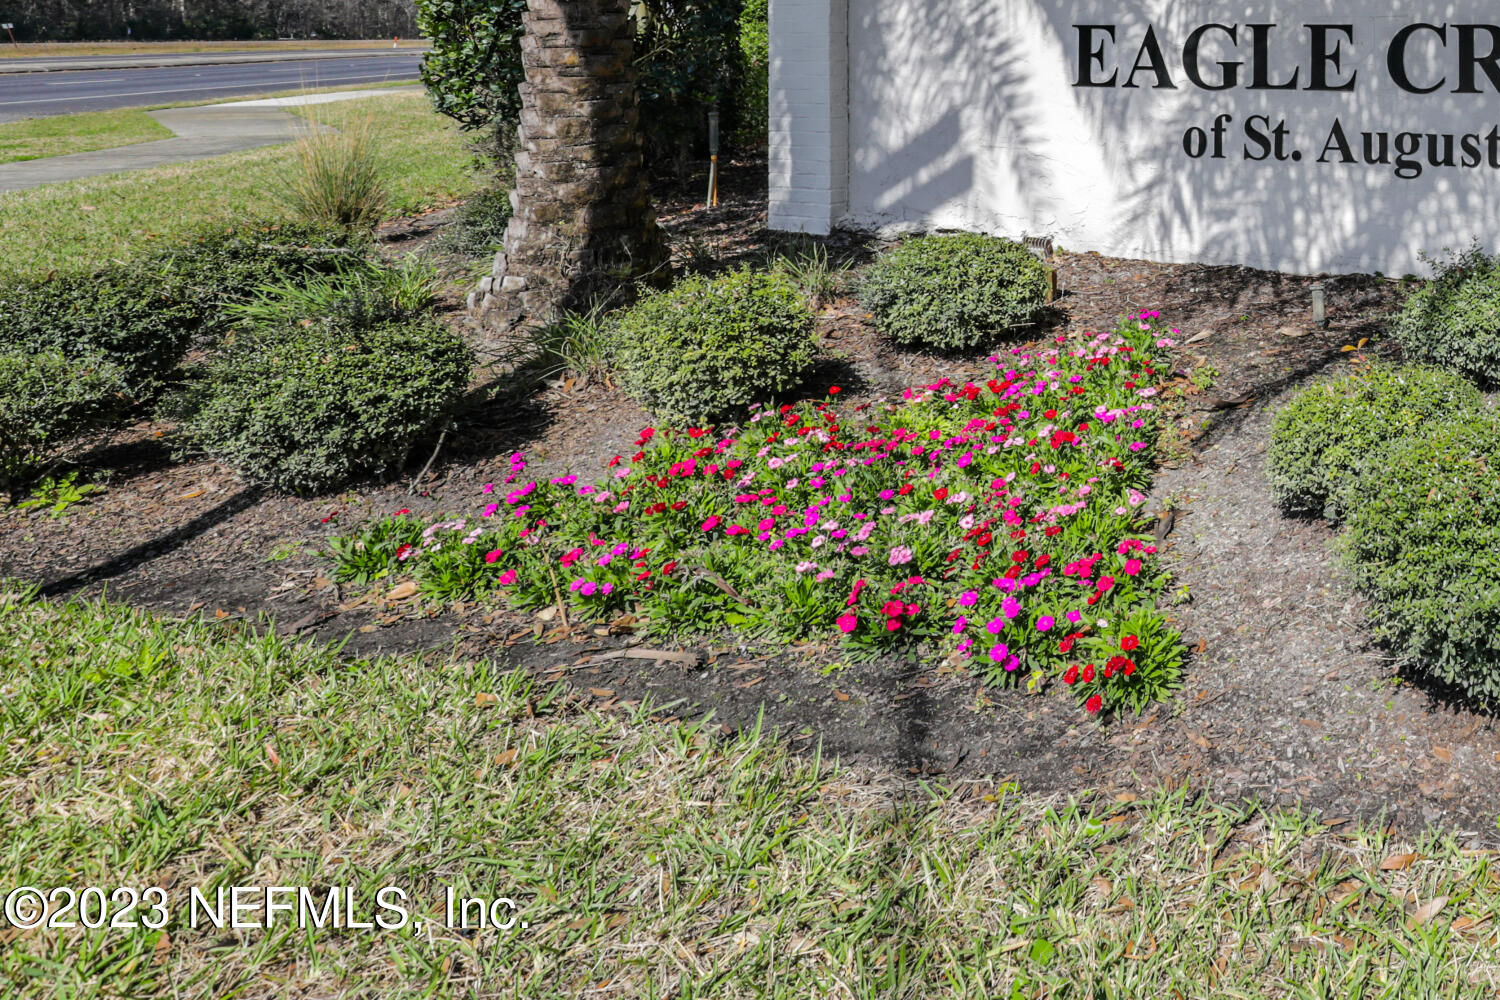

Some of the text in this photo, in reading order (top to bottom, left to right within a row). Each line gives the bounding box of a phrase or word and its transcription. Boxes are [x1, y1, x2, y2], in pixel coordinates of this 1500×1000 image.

[1071, 23, 1358, 92] EAGLE
[1182, 113, 1233, 160] of
[1243, 114, 1302, 162] St.
